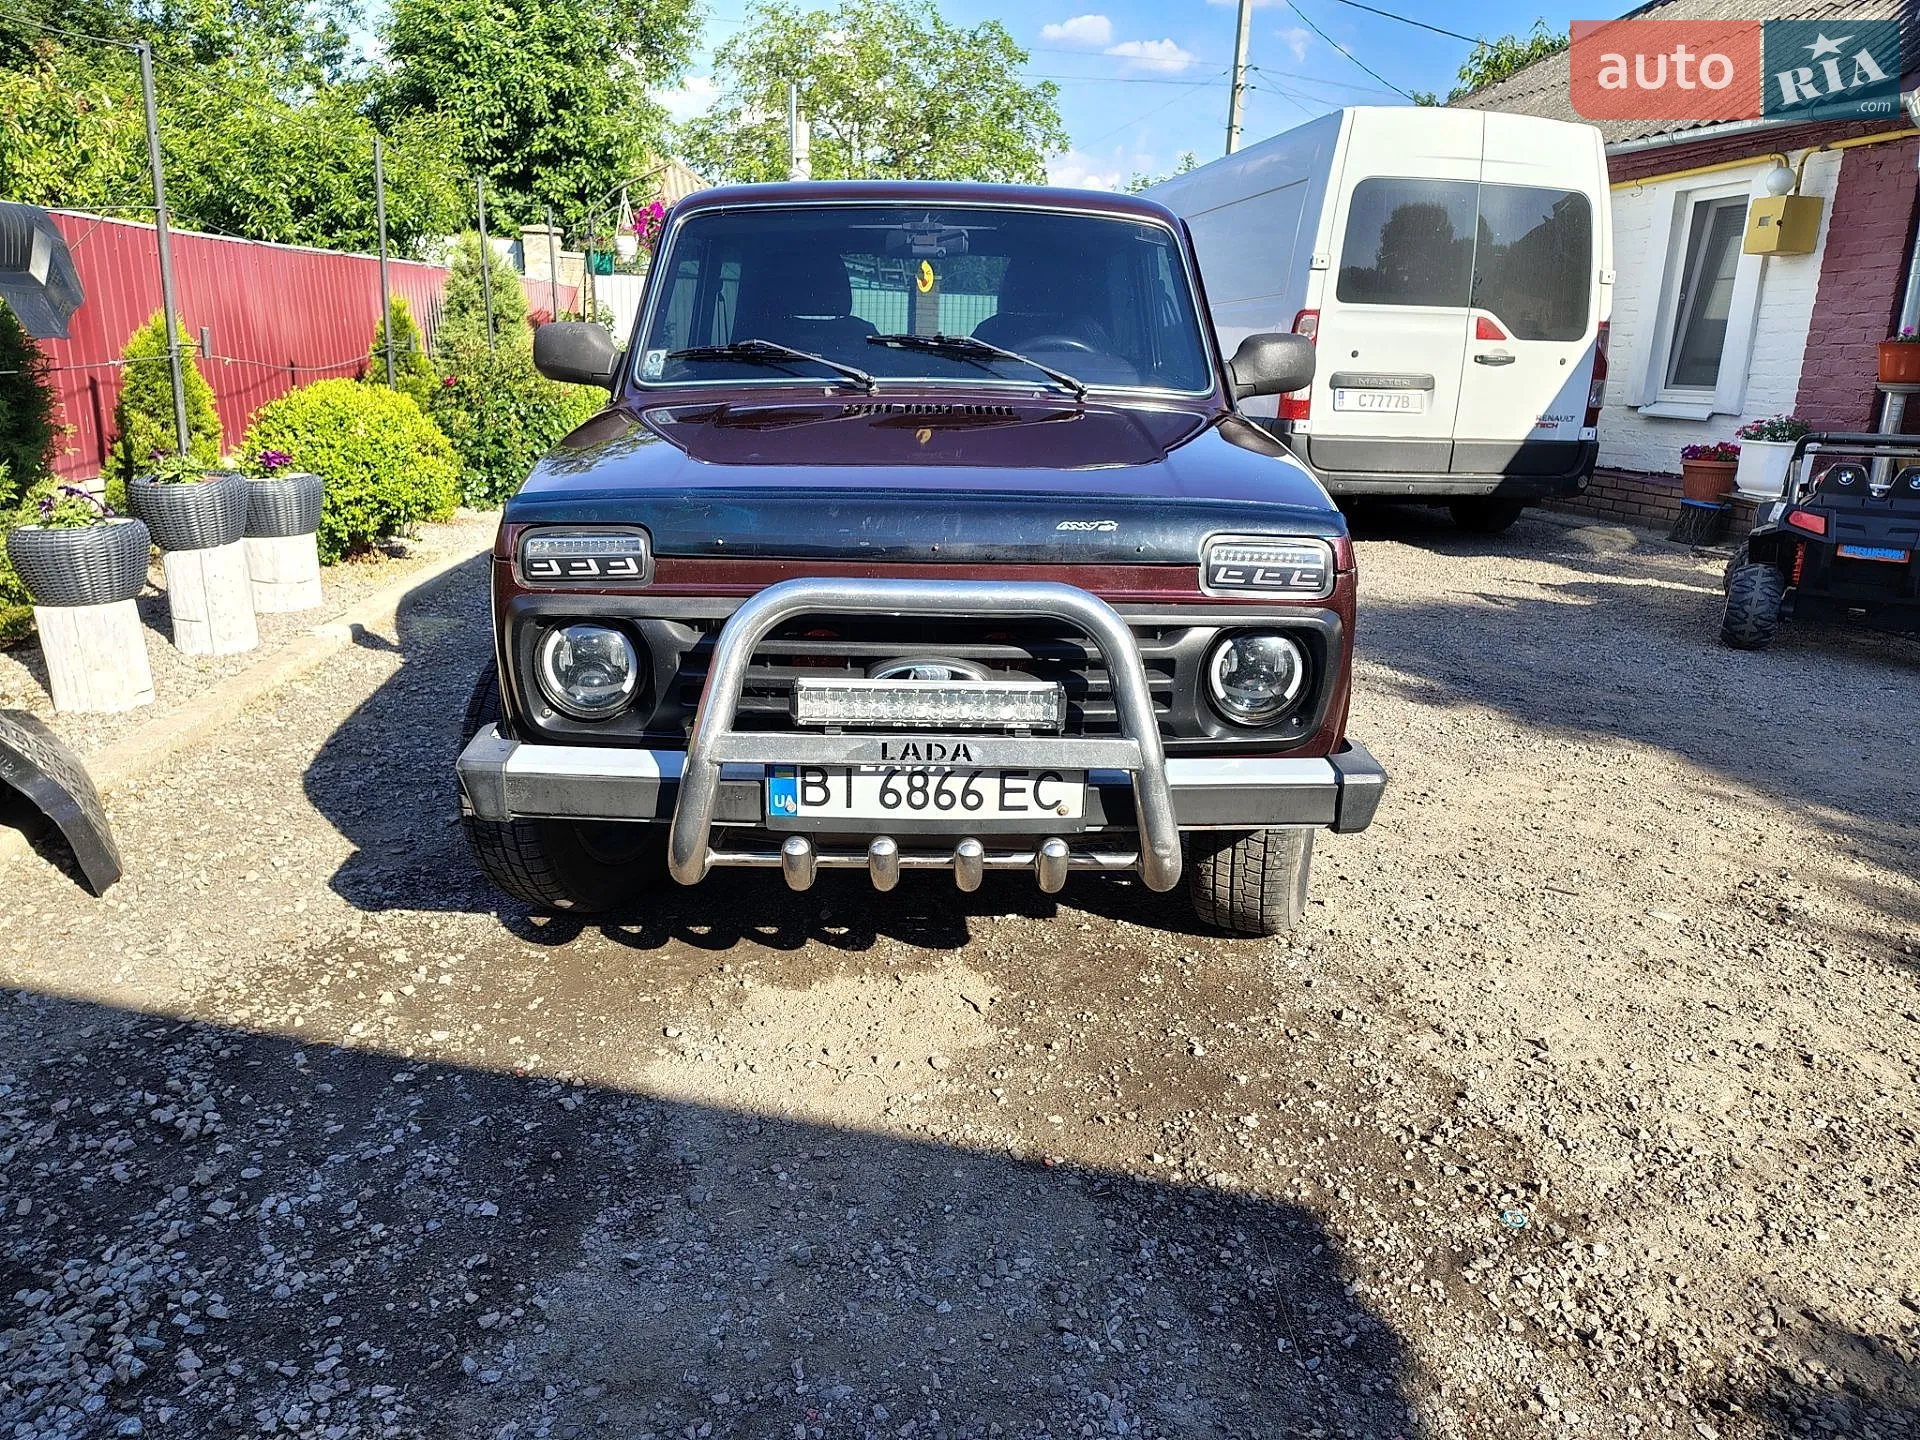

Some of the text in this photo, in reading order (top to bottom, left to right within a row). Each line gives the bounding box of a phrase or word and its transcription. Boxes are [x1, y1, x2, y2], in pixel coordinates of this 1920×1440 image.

[1358, 378, 1411, 388] MASTER
[1358, 394, 1410, 409] C7777B
[1536, 415, 1575, 423] RENAULT
[881, 742, 973, 762] LADA
[879, 769, 985, 811] 6866
[998, 770, 1065, 812] EC
